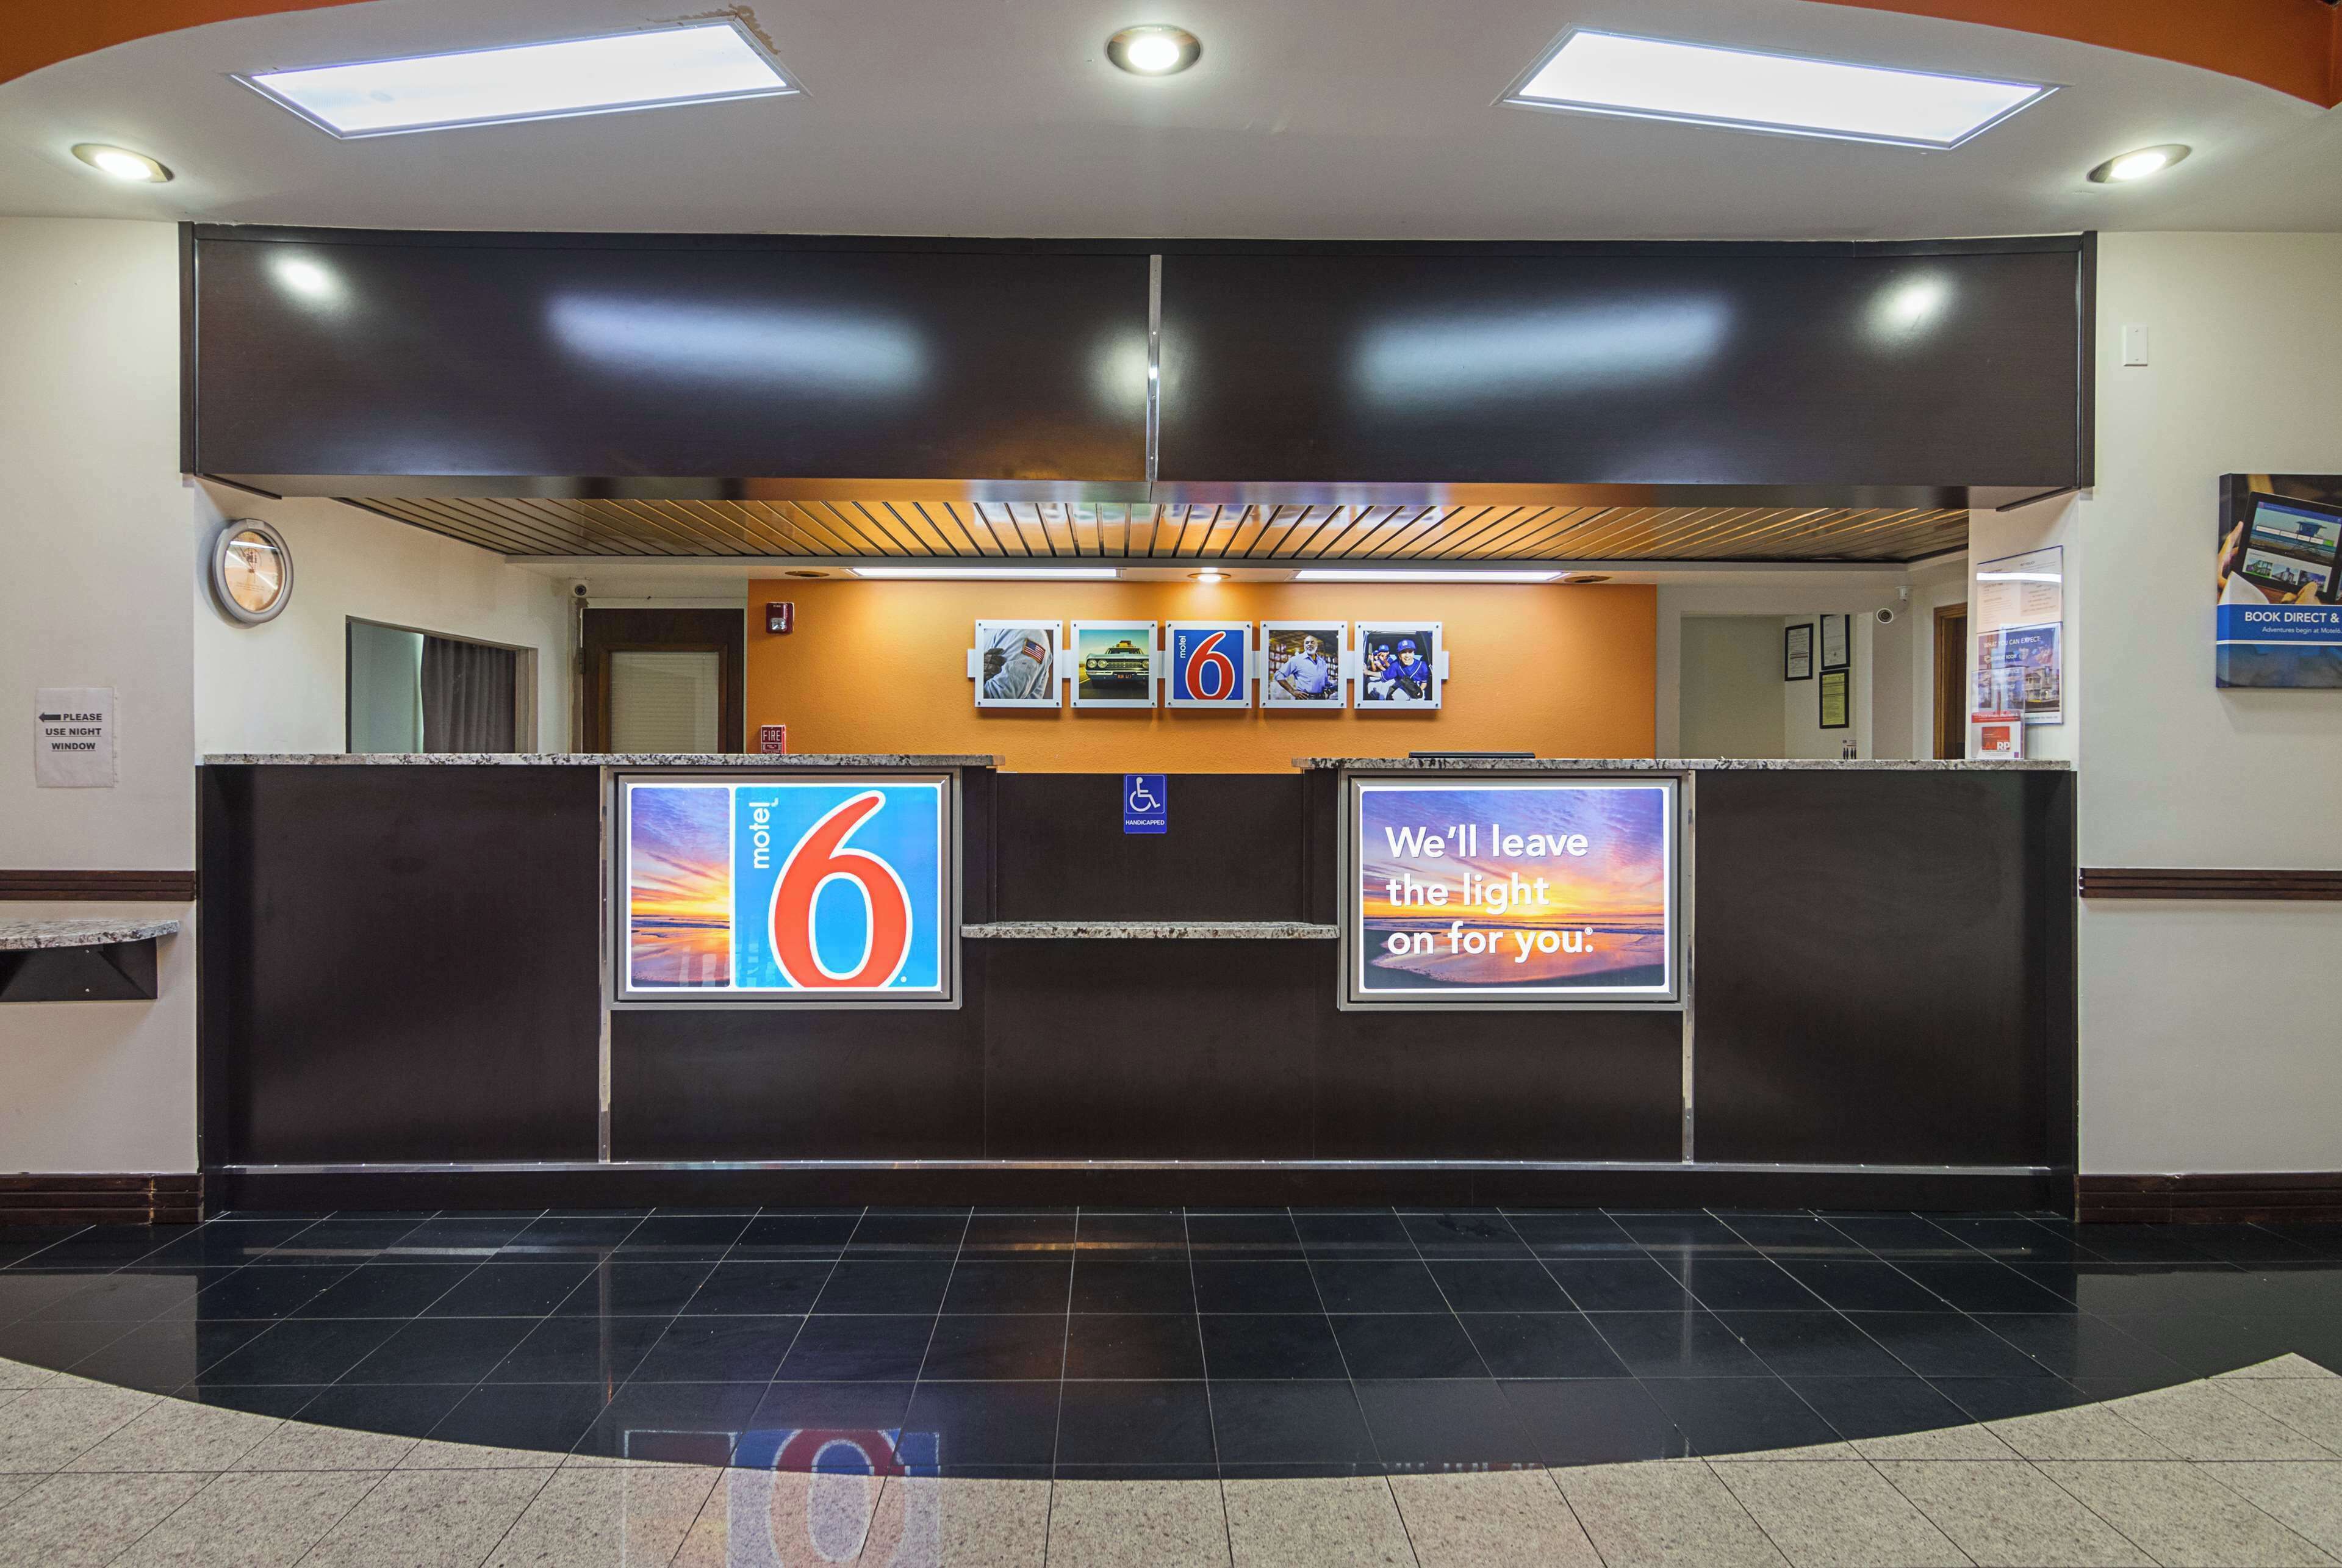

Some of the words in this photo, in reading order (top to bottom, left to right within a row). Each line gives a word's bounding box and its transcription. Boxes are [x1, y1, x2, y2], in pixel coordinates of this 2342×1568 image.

[2245, 611, 2280, 622] BOOK
[2284, 612, 2327, 622] DIRECT
[2330, 613, 2339, 623] &
[1185, 631, 1235, 700] 6
[763, 730, 780, 741] FIRE
[1385, 824, 1477, 858] We'll
[1492, 824, 1589, 857] leave
[749, 802, 770, 869] motel
[768, 790, 913, 988] 6
[1385, 872, 1449, 907] the
[1463, 872, 1550, 915] light
[1387, 931, 1434, 955] on
[1446, 921, 1504, 954] for
